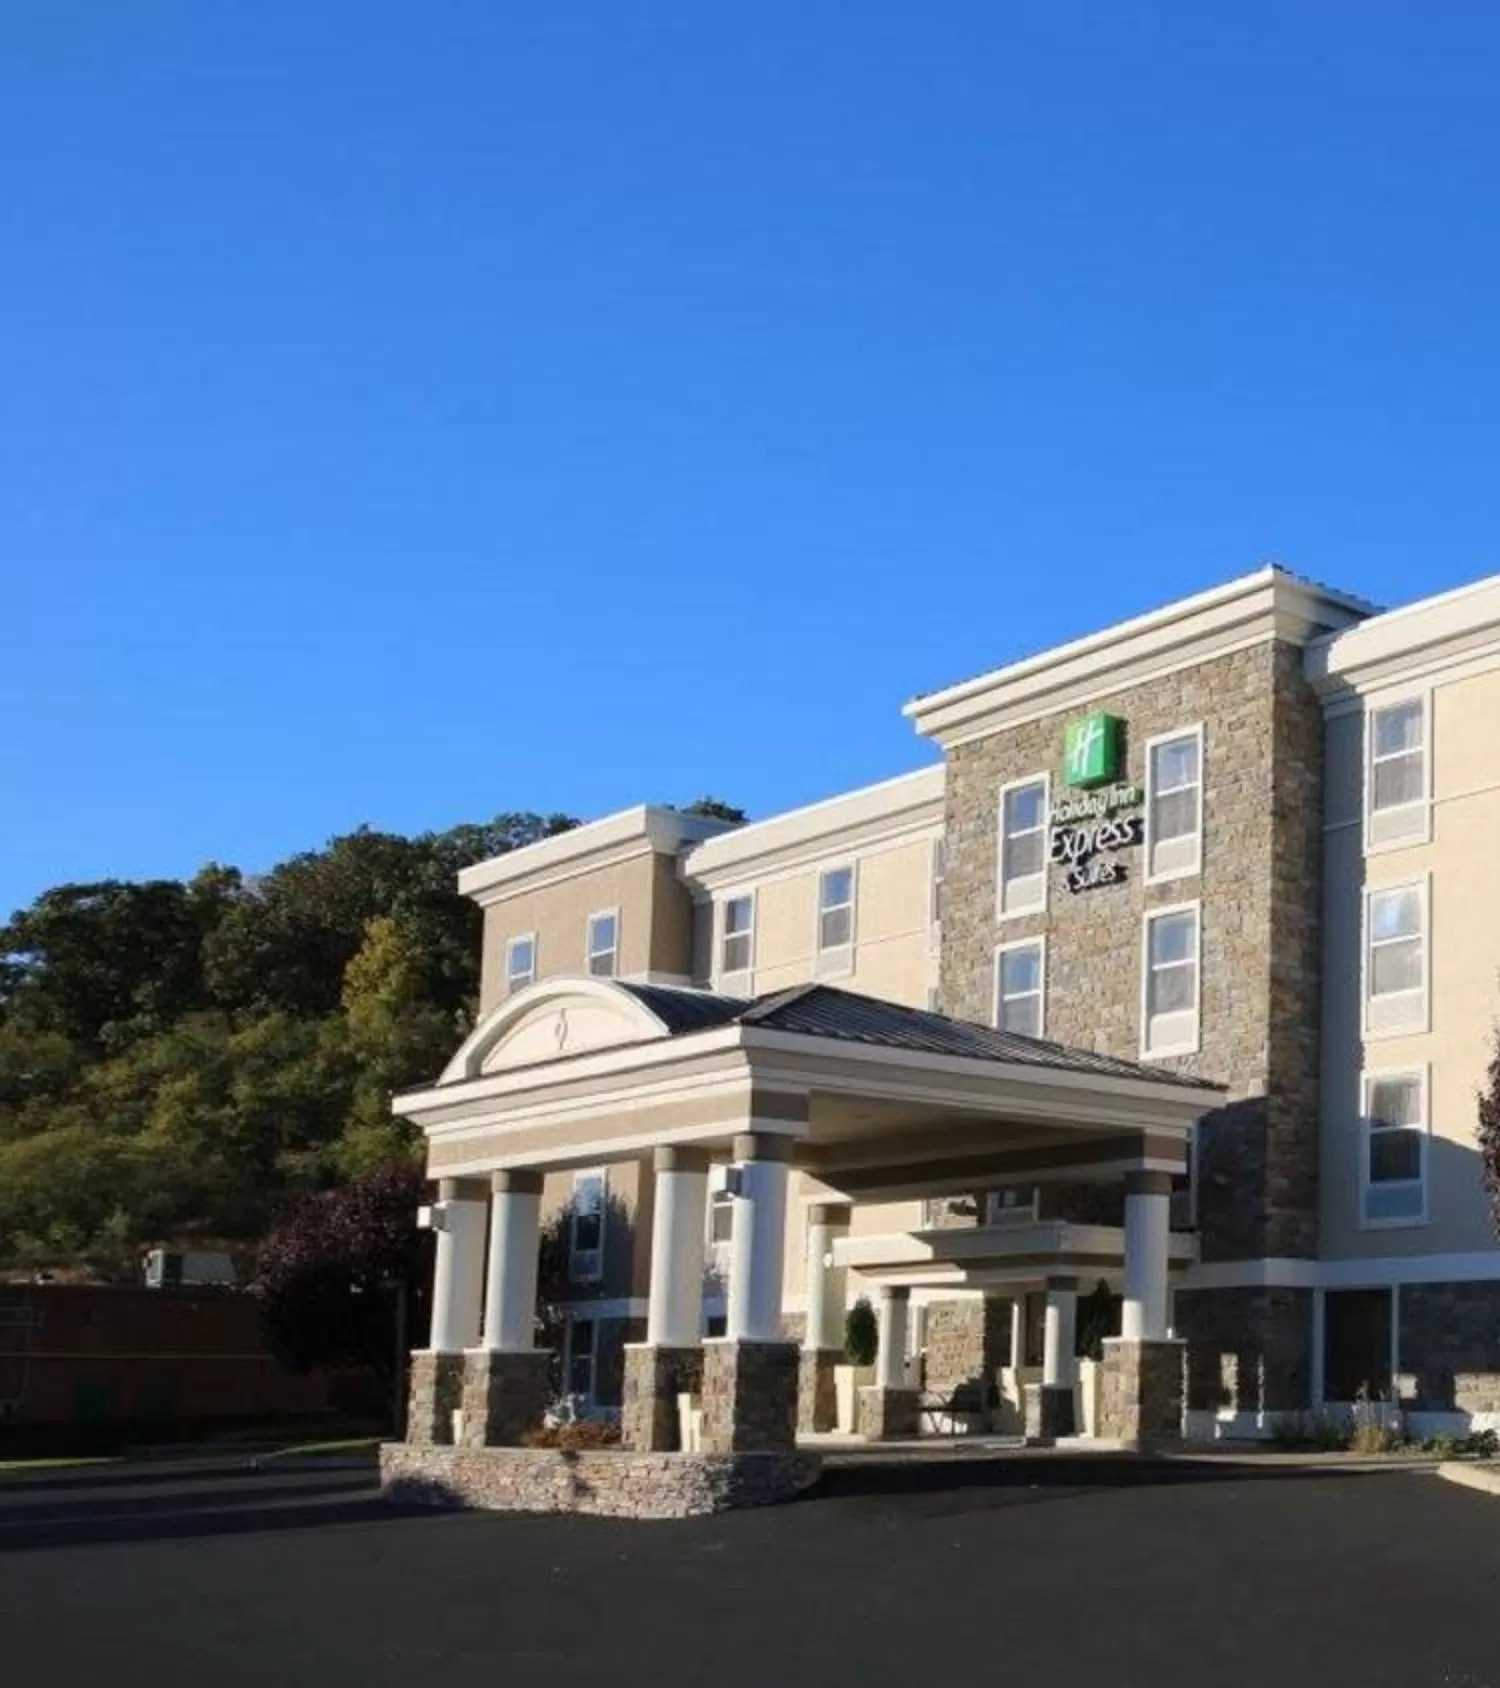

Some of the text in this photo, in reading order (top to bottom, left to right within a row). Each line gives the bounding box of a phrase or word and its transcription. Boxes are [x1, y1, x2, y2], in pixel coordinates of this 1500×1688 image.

[1049, 783, 1136, 825] Holiday Inn
[1049, 815, 1136, 868] Express
[1072, 858, 1117, 889] Suites
